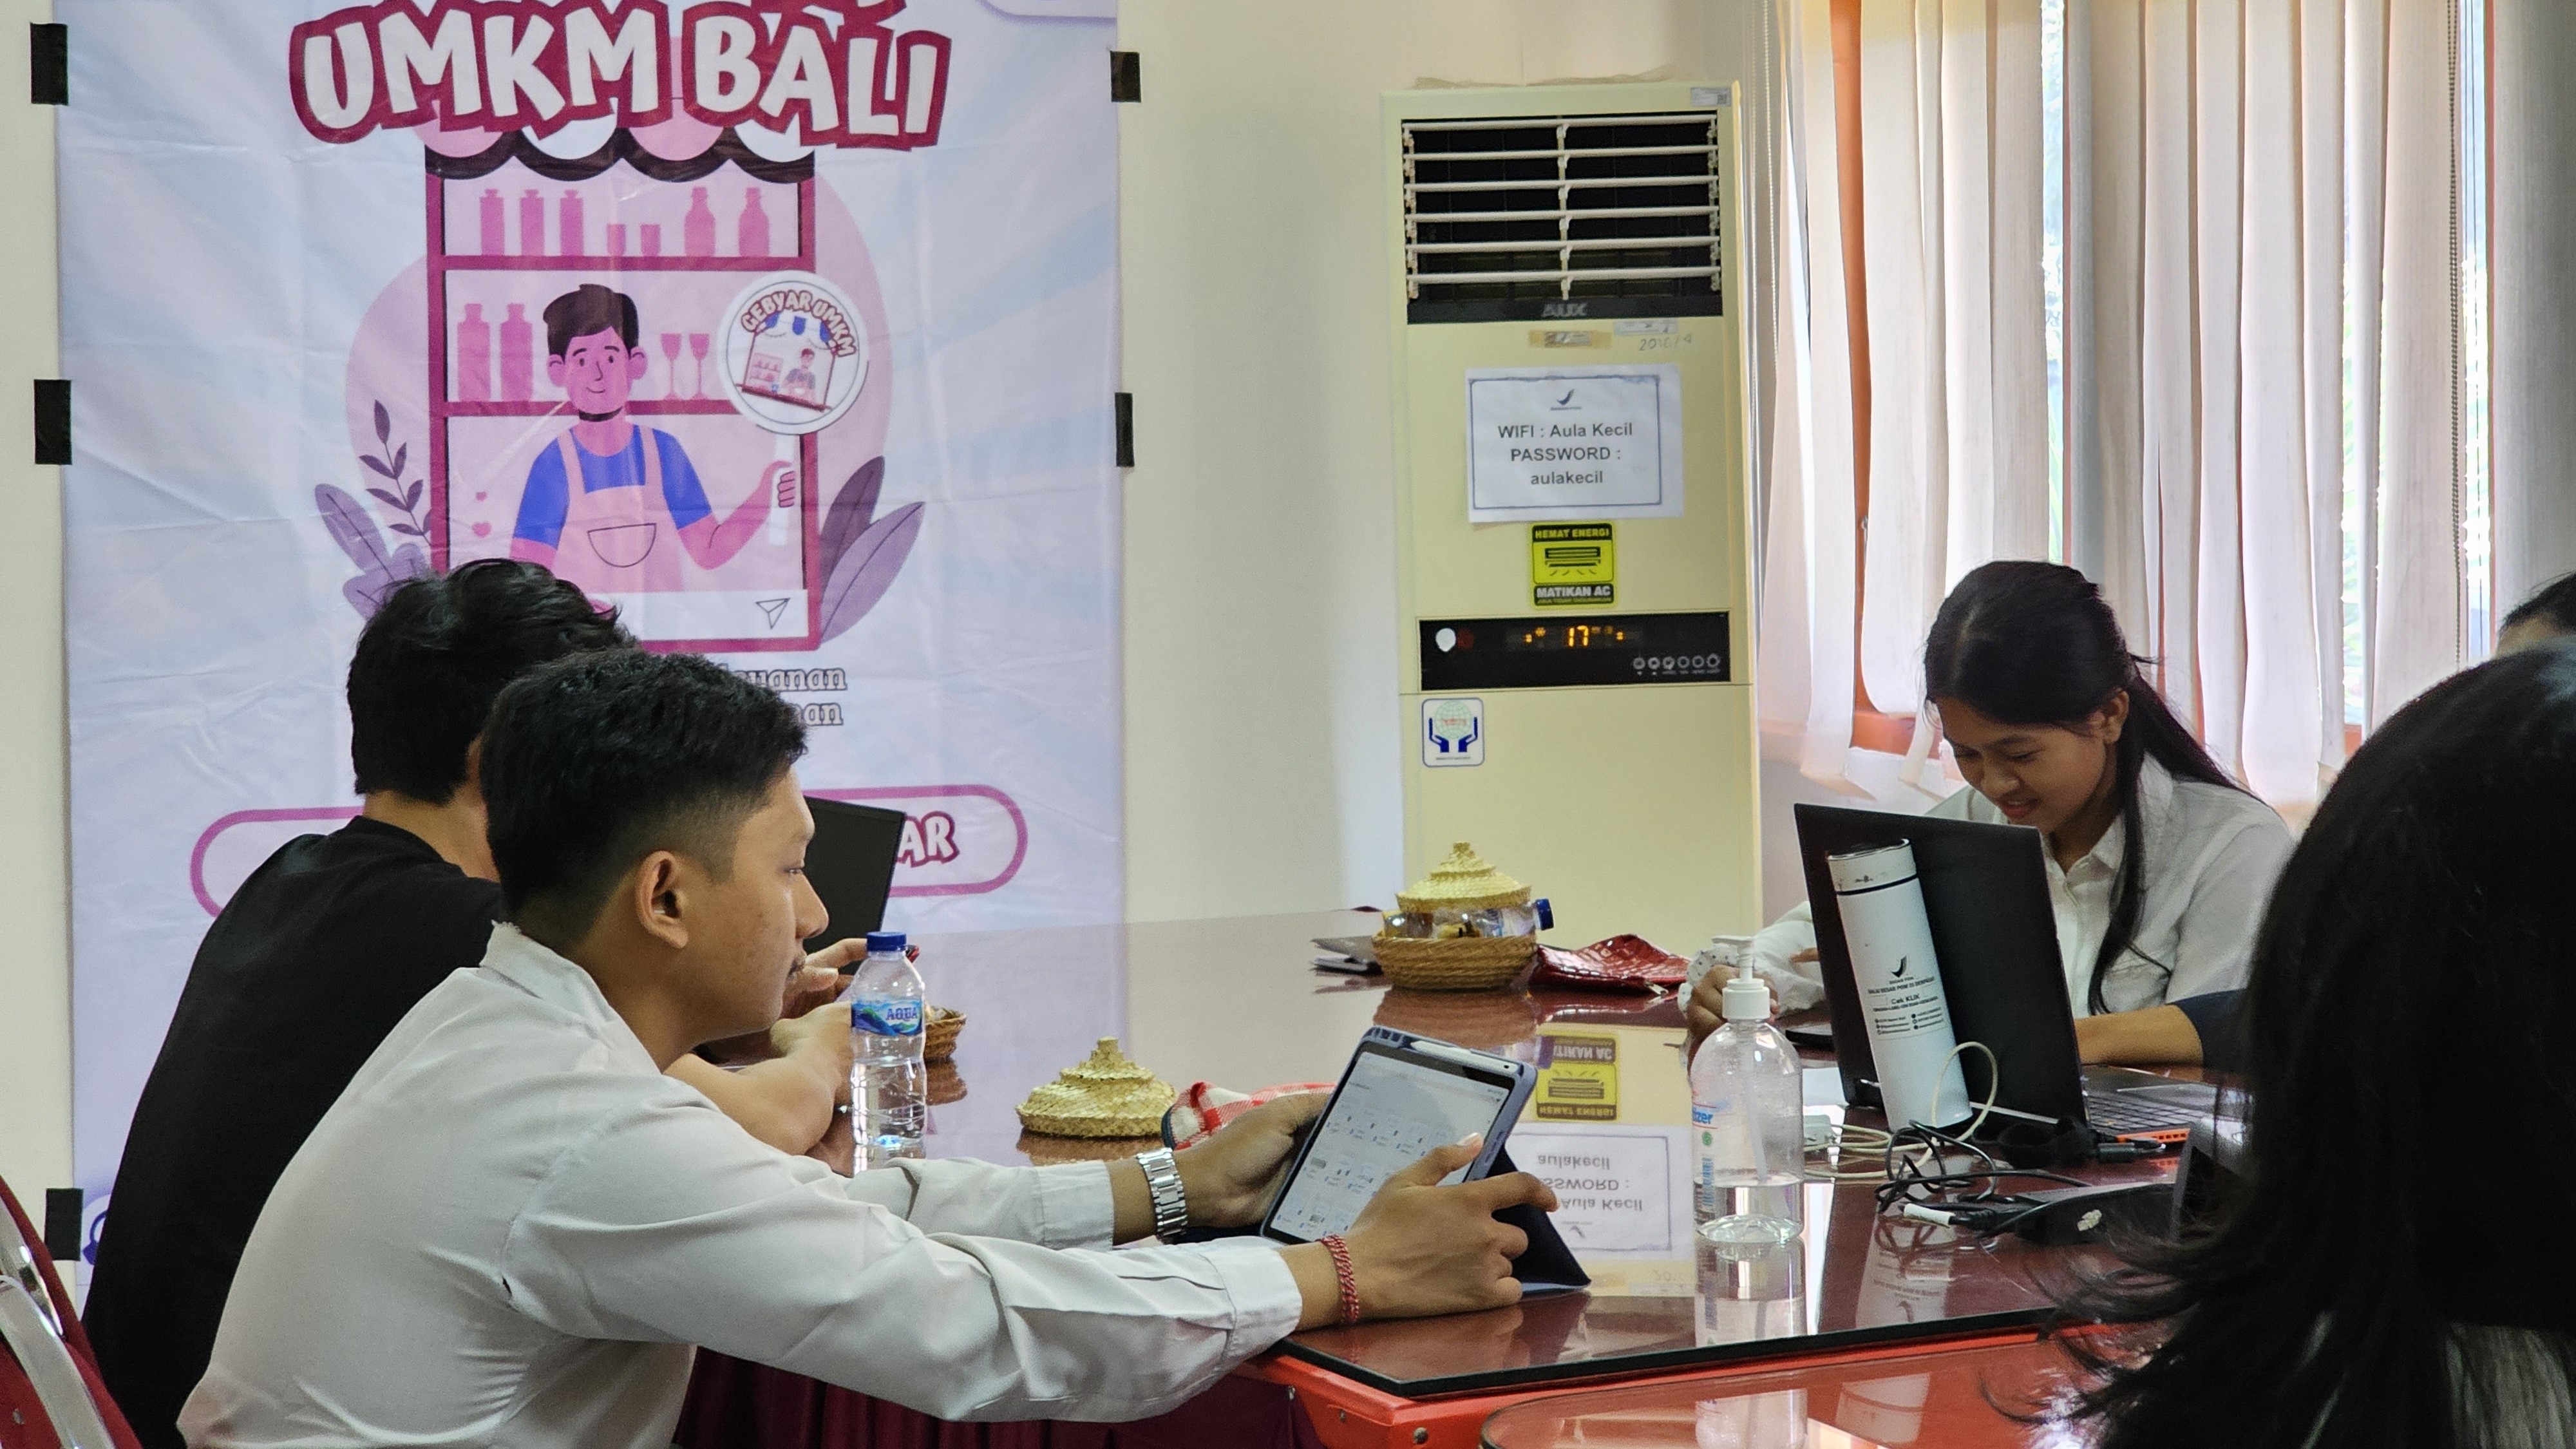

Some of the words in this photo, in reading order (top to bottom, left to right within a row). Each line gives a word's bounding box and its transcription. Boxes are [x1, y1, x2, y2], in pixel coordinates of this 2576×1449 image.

[292, 2, 671, 140] UMKM
[685, 3, 951, 149] BALI
[1542, 303, 1588, 317] AUX
[741, 290, 813, 332] GEBYAR
[811, 299, 857, 357] UMKM
[1498, 425, 1534, 438] WIFI
[1549, 424, 1586, 437] Aula
[1592, 422, 1633, 437] Kecil
[1510, 447, 1611, 461] PASSWORD
[1531, 471, 1603, 484] aulakecil
[1535, 529, 1570, 538] HEMAT
[1572, 527, 1610, 537] ENERGI
[1537, 586, 1591, 598] MATIKAN
[1593, 585, 1611, 596] AC
[1567, 625, 1589, 647] 17
[886, 1007, 918, 1021] AQUA
